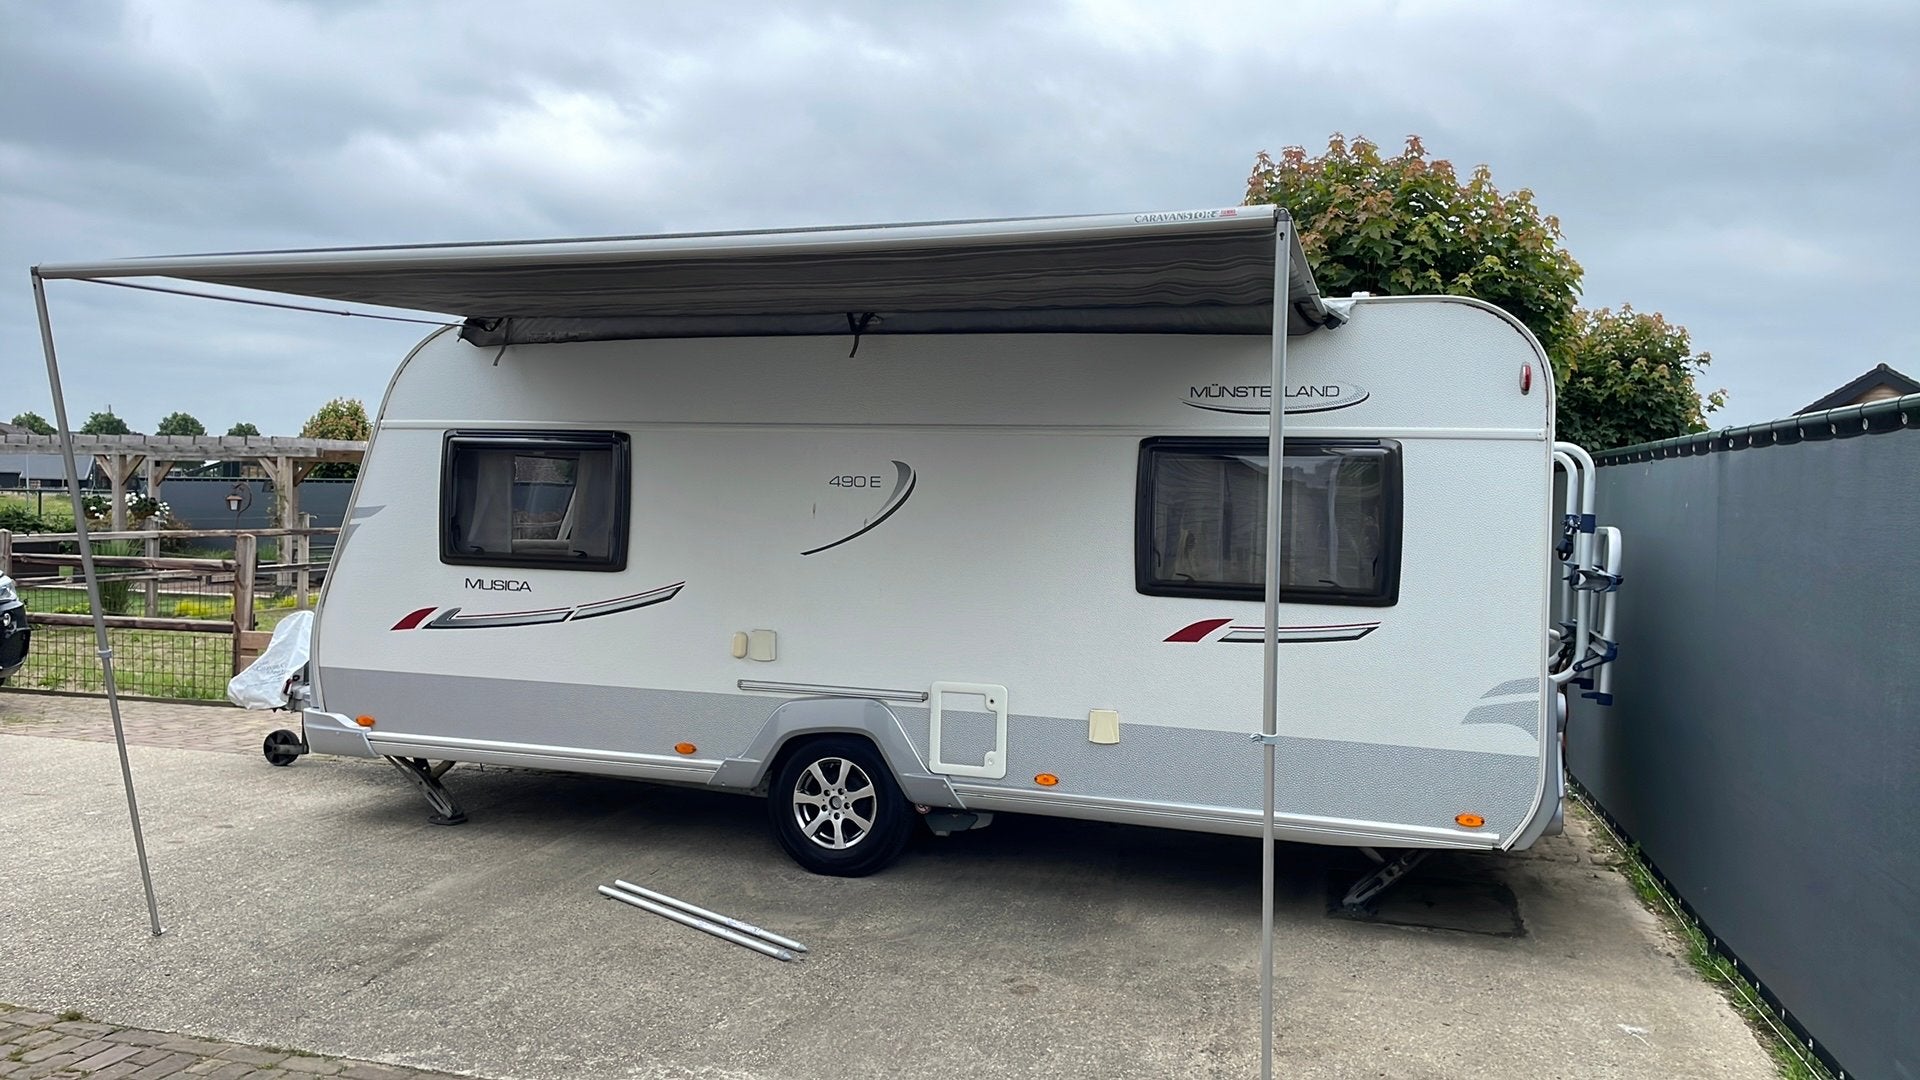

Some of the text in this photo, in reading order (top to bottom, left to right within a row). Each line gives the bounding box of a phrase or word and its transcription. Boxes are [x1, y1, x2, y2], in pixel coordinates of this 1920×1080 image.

[1190, 384, 1340, 398] MÜNSTELAND
[829, 475, 881, 488] 490 E
[465, 577, 532, 593] MUSICA
